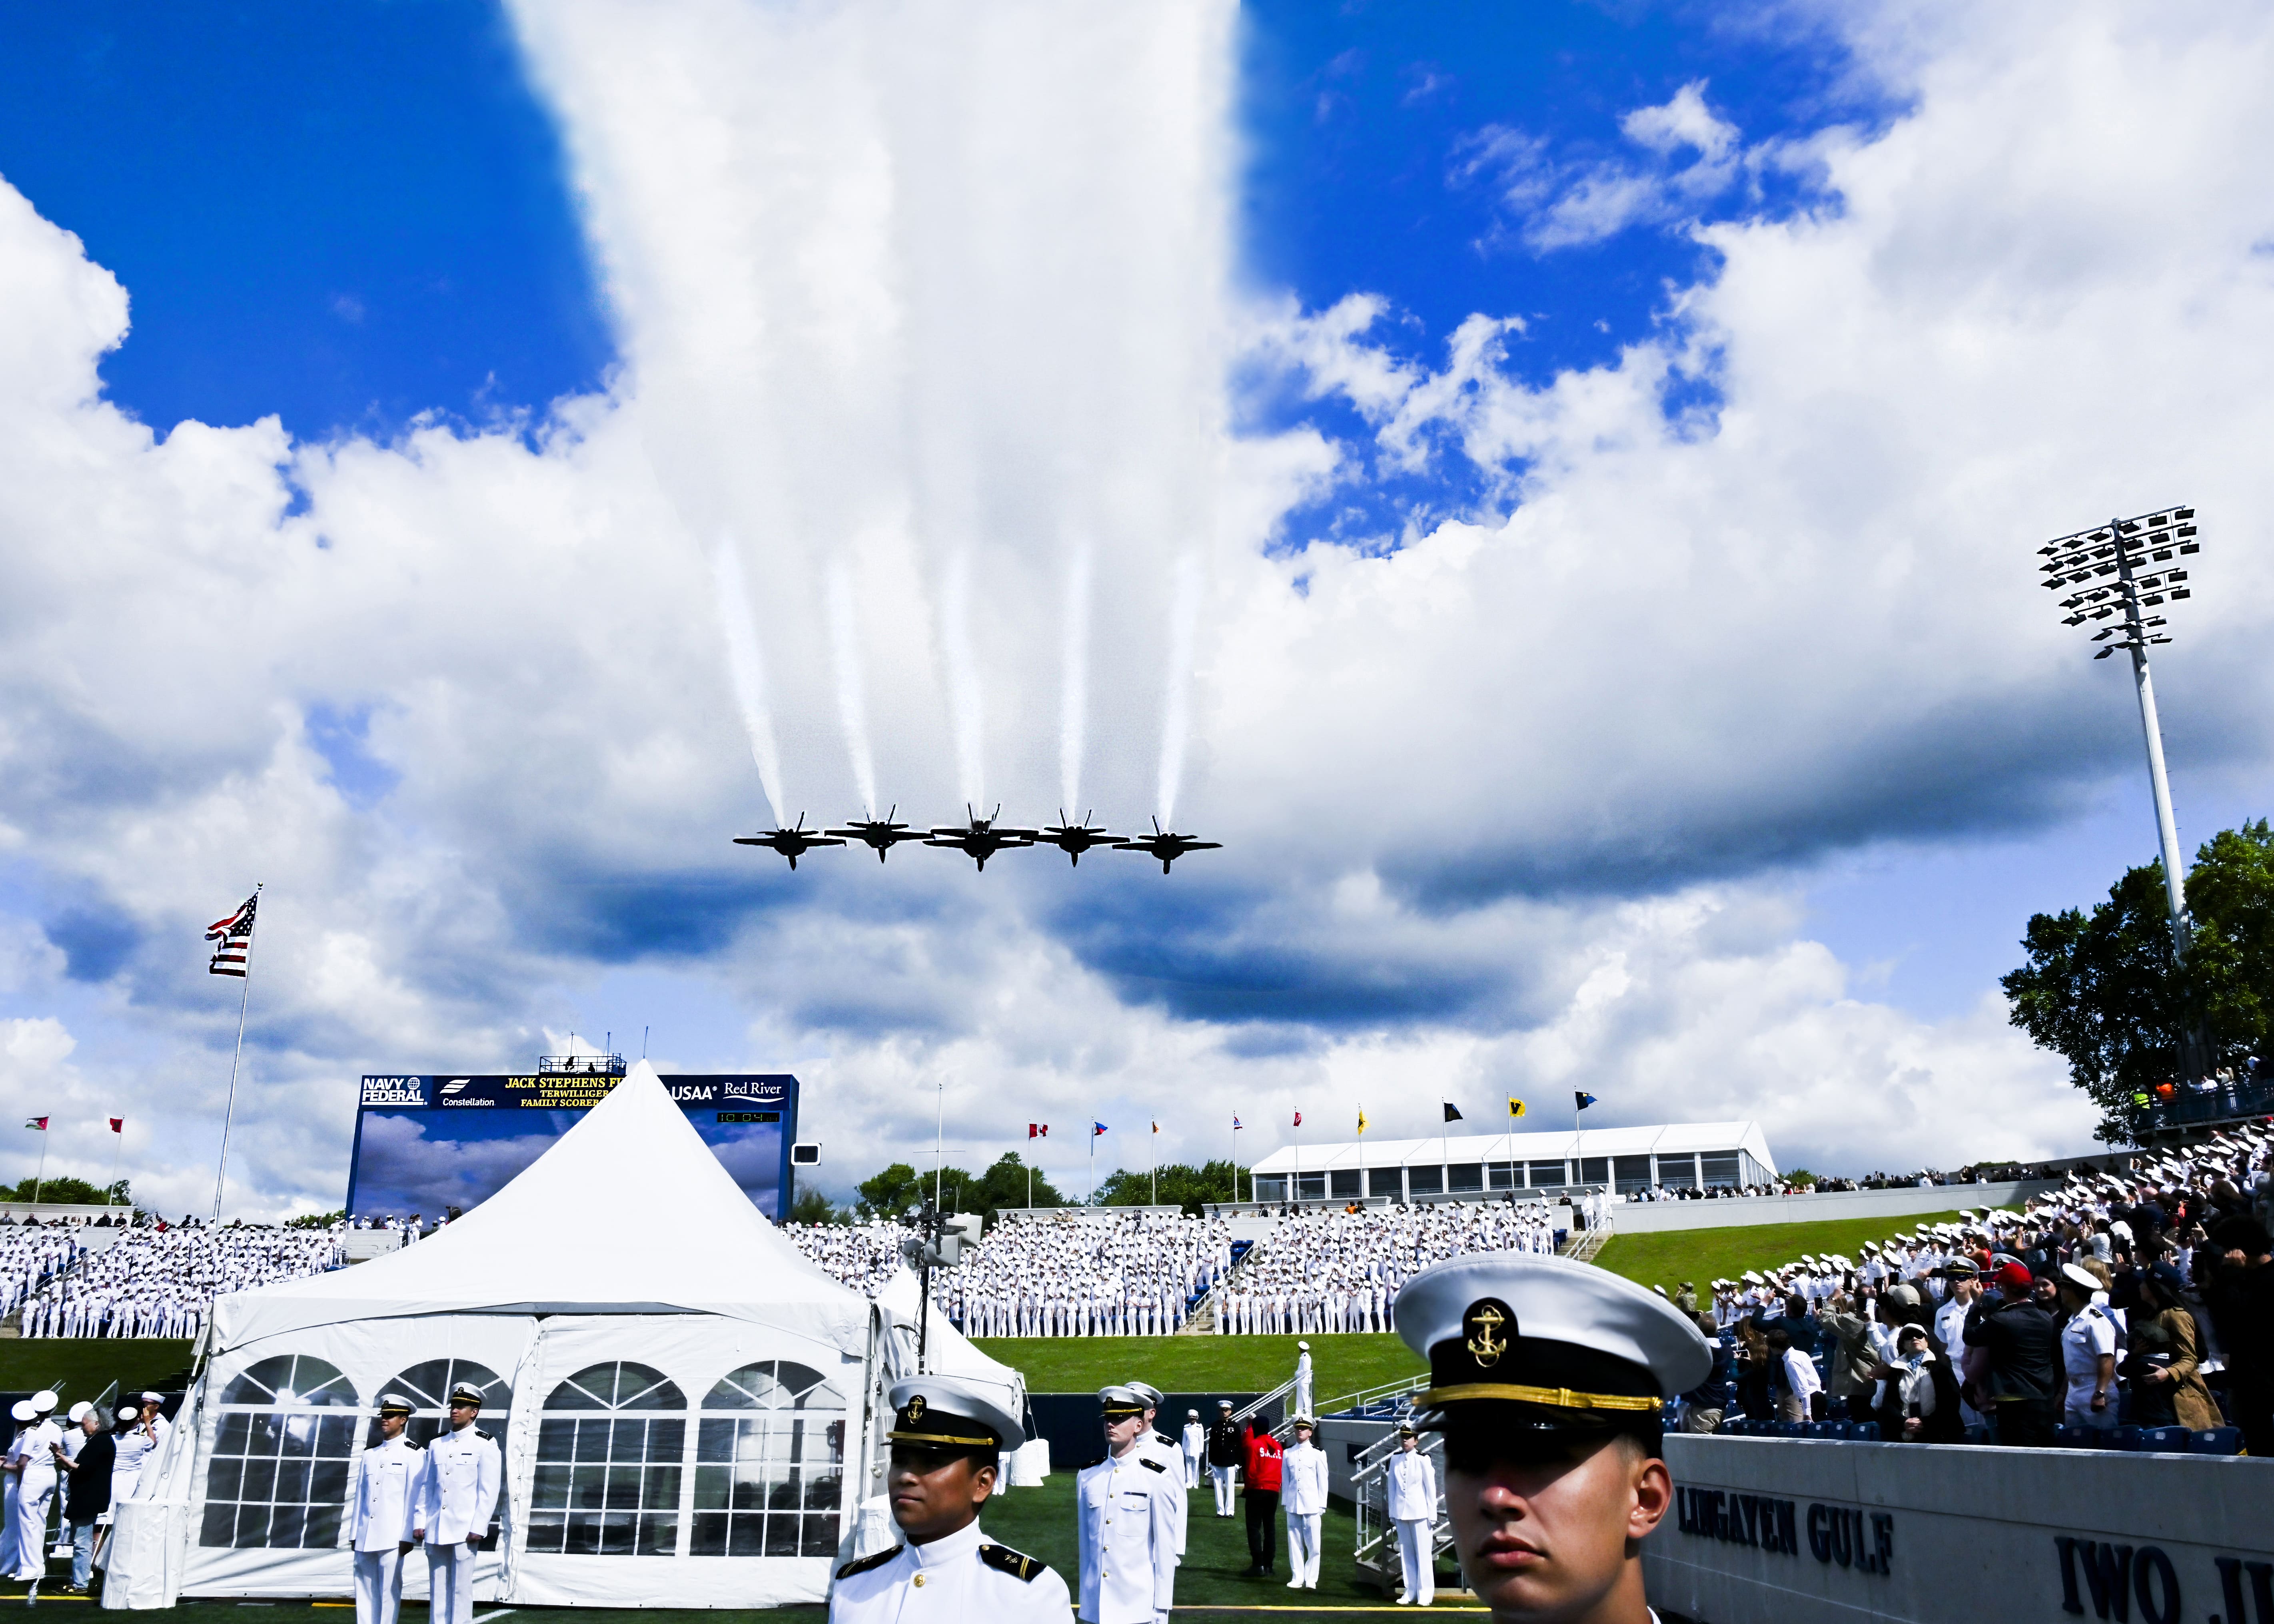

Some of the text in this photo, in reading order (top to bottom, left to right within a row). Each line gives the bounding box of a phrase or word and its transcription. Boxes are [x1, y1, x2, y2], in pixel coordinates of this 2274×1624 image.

[363, 1078, 405, 1090] NAVY
[505, 1077, 536, 1088] JACK
[539, 1077, 606, 1088] STEPHENS
[724, 1082, 782, 1094] Red River
[362, 1090, 424, 1101] FEDERAL
[443, 1098, 494, 1106] Constellation
[1675, 1486, 1894, 1576] LINGAYEN GULF
[2054, 1536, 2181, 1624] IWO
